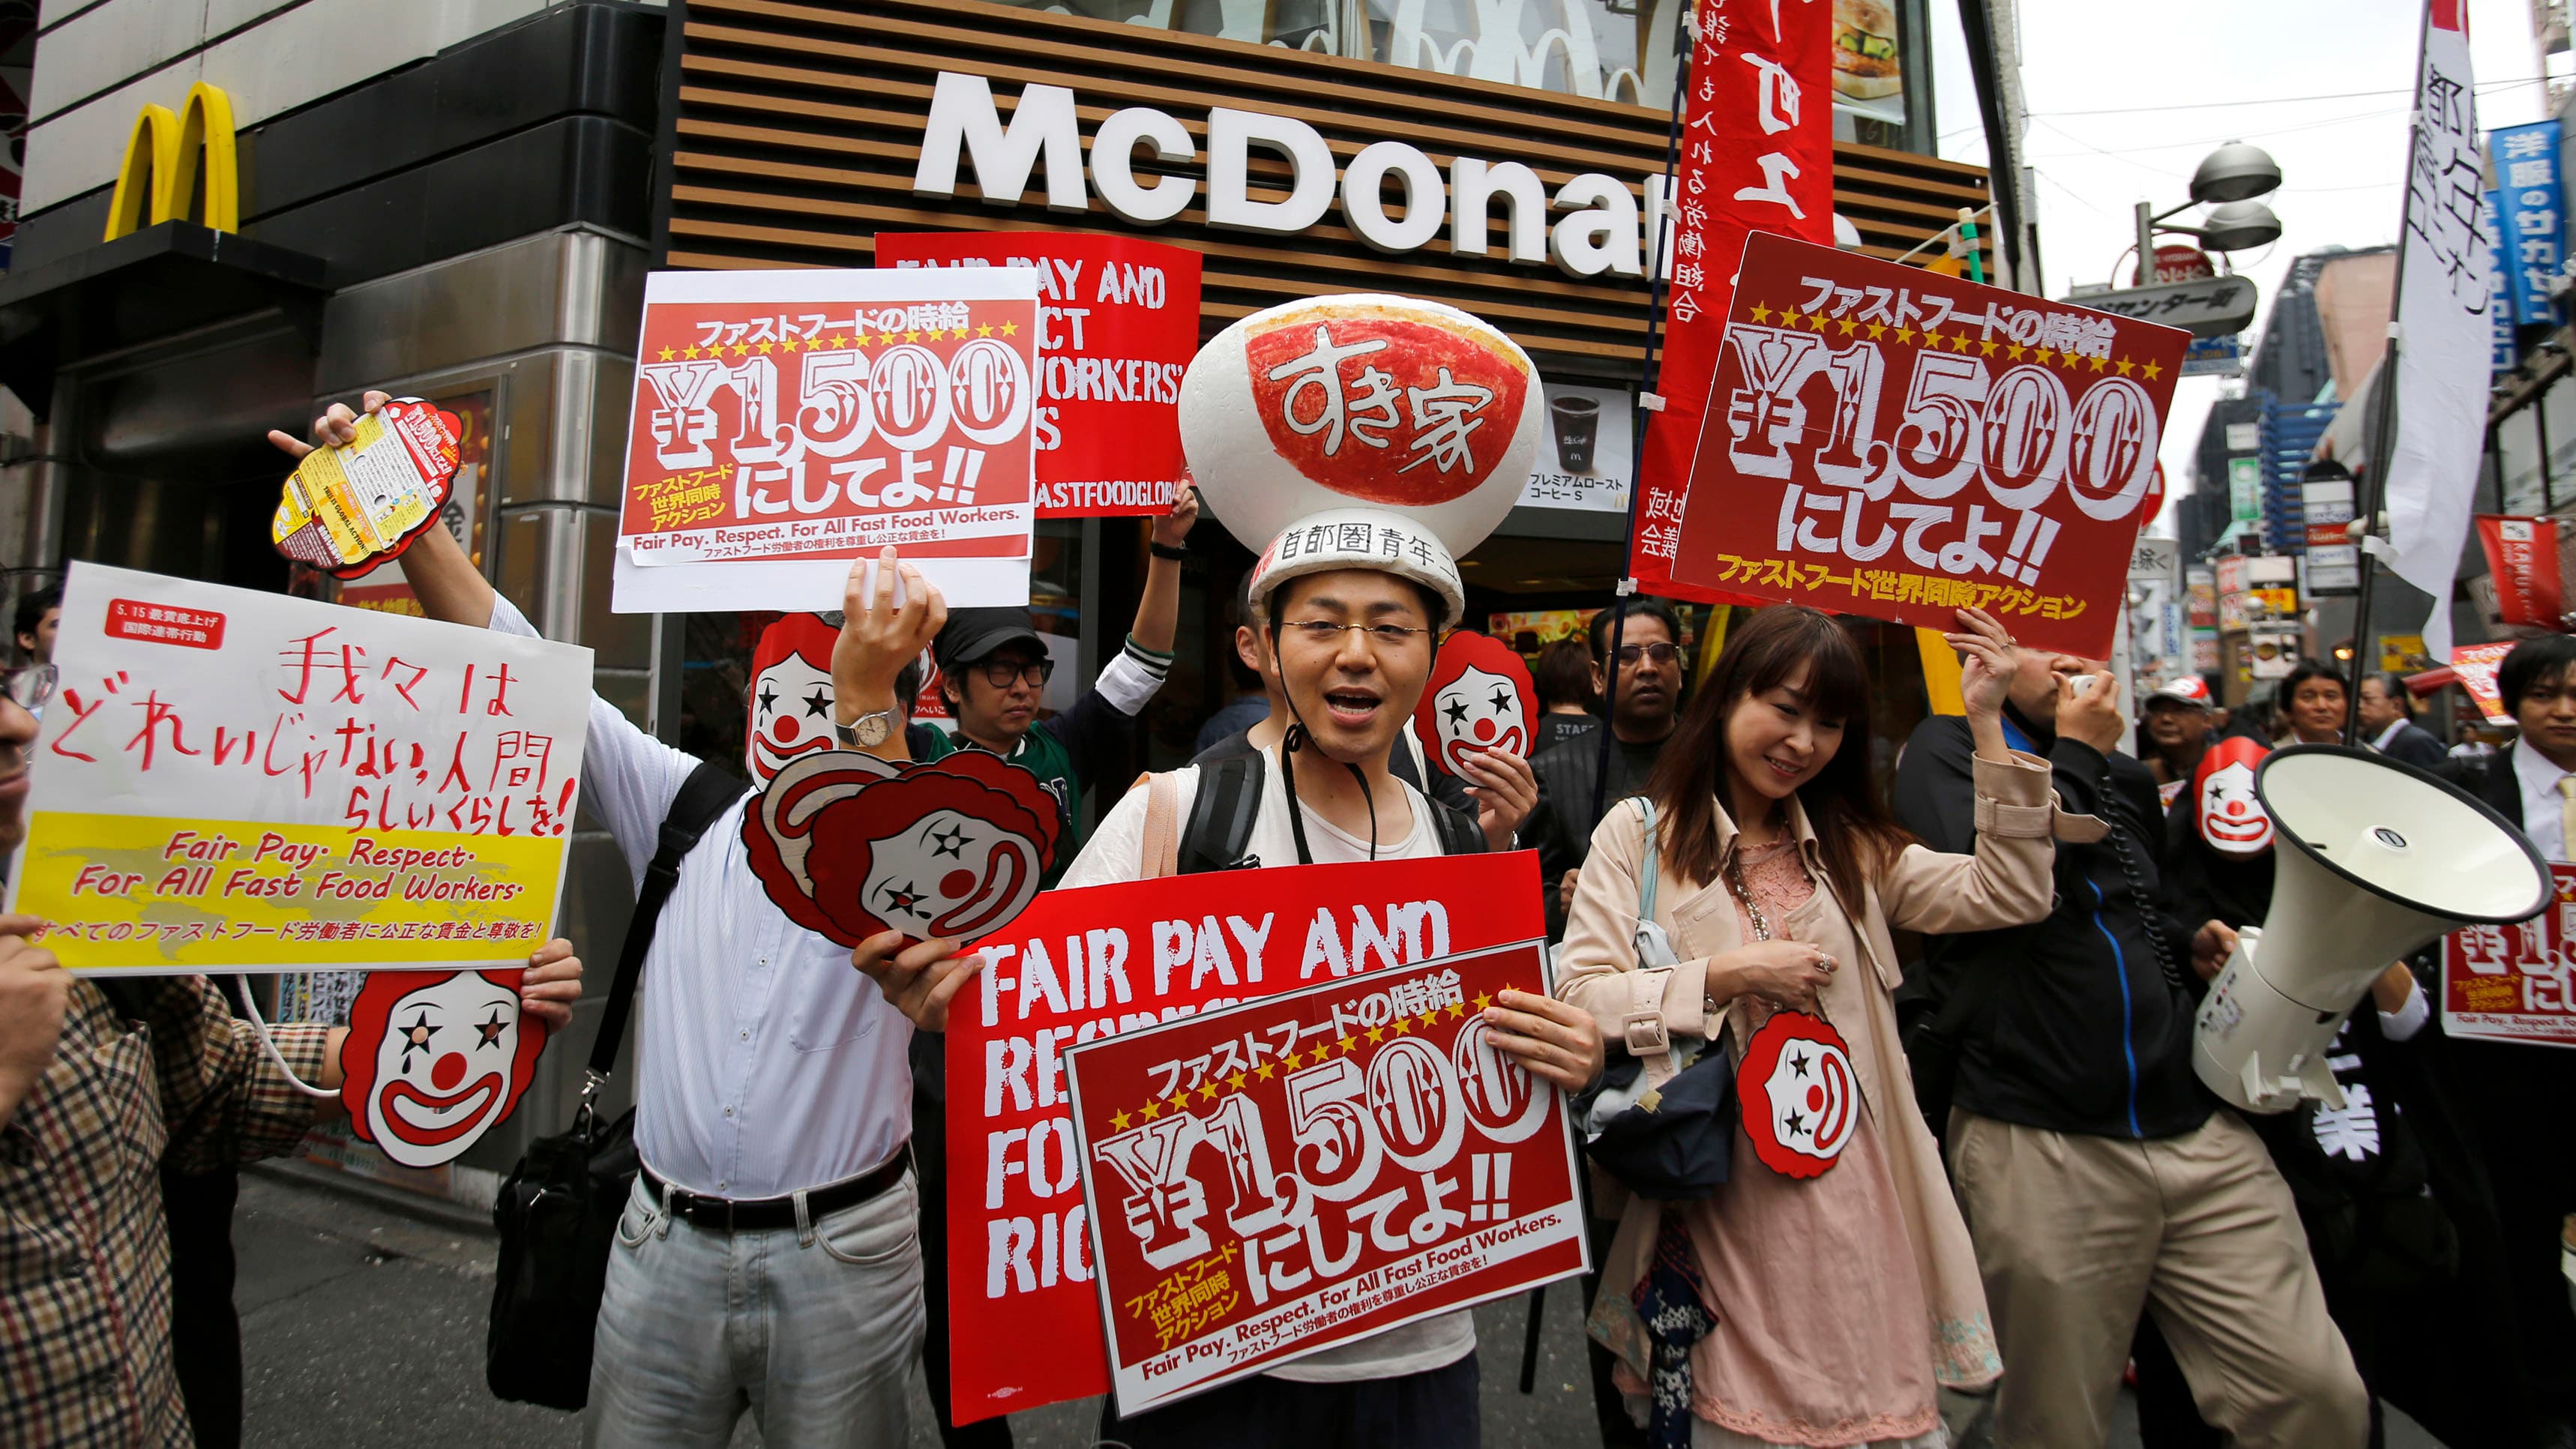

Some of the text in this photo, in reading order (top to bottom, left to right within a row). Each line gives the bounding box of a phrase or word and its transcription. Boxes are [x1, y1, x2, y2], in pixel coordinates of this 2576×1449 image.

[1006, 256, 1166, 310] AY AND
[1800, 275, 2118, 360] ファストフードの時給
[696, 301, 972, 349] ファストフードの時給
[640, 337, 1031, 471] ¥1,500
[1268, 325, 1494, 475] すき家
[1725, 322, 2160, 521] ¥1,500
[633, 463, 735, 501] ファストフード
[650, 483, 722, 514] 世界同時
[650, 501, 726, 532] アクション
[734, 448, 986, 519] にしてよ!!
[1530, 474, 1623, 491] プレミアムロースト
[1531, 487, 1583, 501] コーヒー S
[633, 507, 1020, 552] Fair Pay. Respect. For All Fast Food Workers.
[1776, 483, 2062, 587] にしてよ!!
[1717, 552, 2089, 621] ファストフード世界同時アクション
[278, 627, 520, 717] 我々は
[164, 831, 244, 862] Fair
[73, 866, 142, 897] For
[157, 866, 211, 898] All
[223, 869, 301, 899] Fast
[315, 869, 391, 900] Food
[979, 900, 1451, 1027] FAIR PAY AND
[1147, 968, 1466, 1100] ファストフードの時給
[2456, 1013, 2478, 1024] Fair
[2481, 1014, 2507, 1028] Pay.
[1093, 1012, 1553, 1272] ¥1,500
[1242, 1151, 1513, 1307] にしてよ!!
[1125, 1239, 1239, 1319] ファストフード
[1141, 1211, 1563, 1382] Fair Pay. Respect. For All Fast Food Workers.
[1149, 1270, 1232, 1330] 世界同時
[1155, 1289, 1241, 1351] アクション
